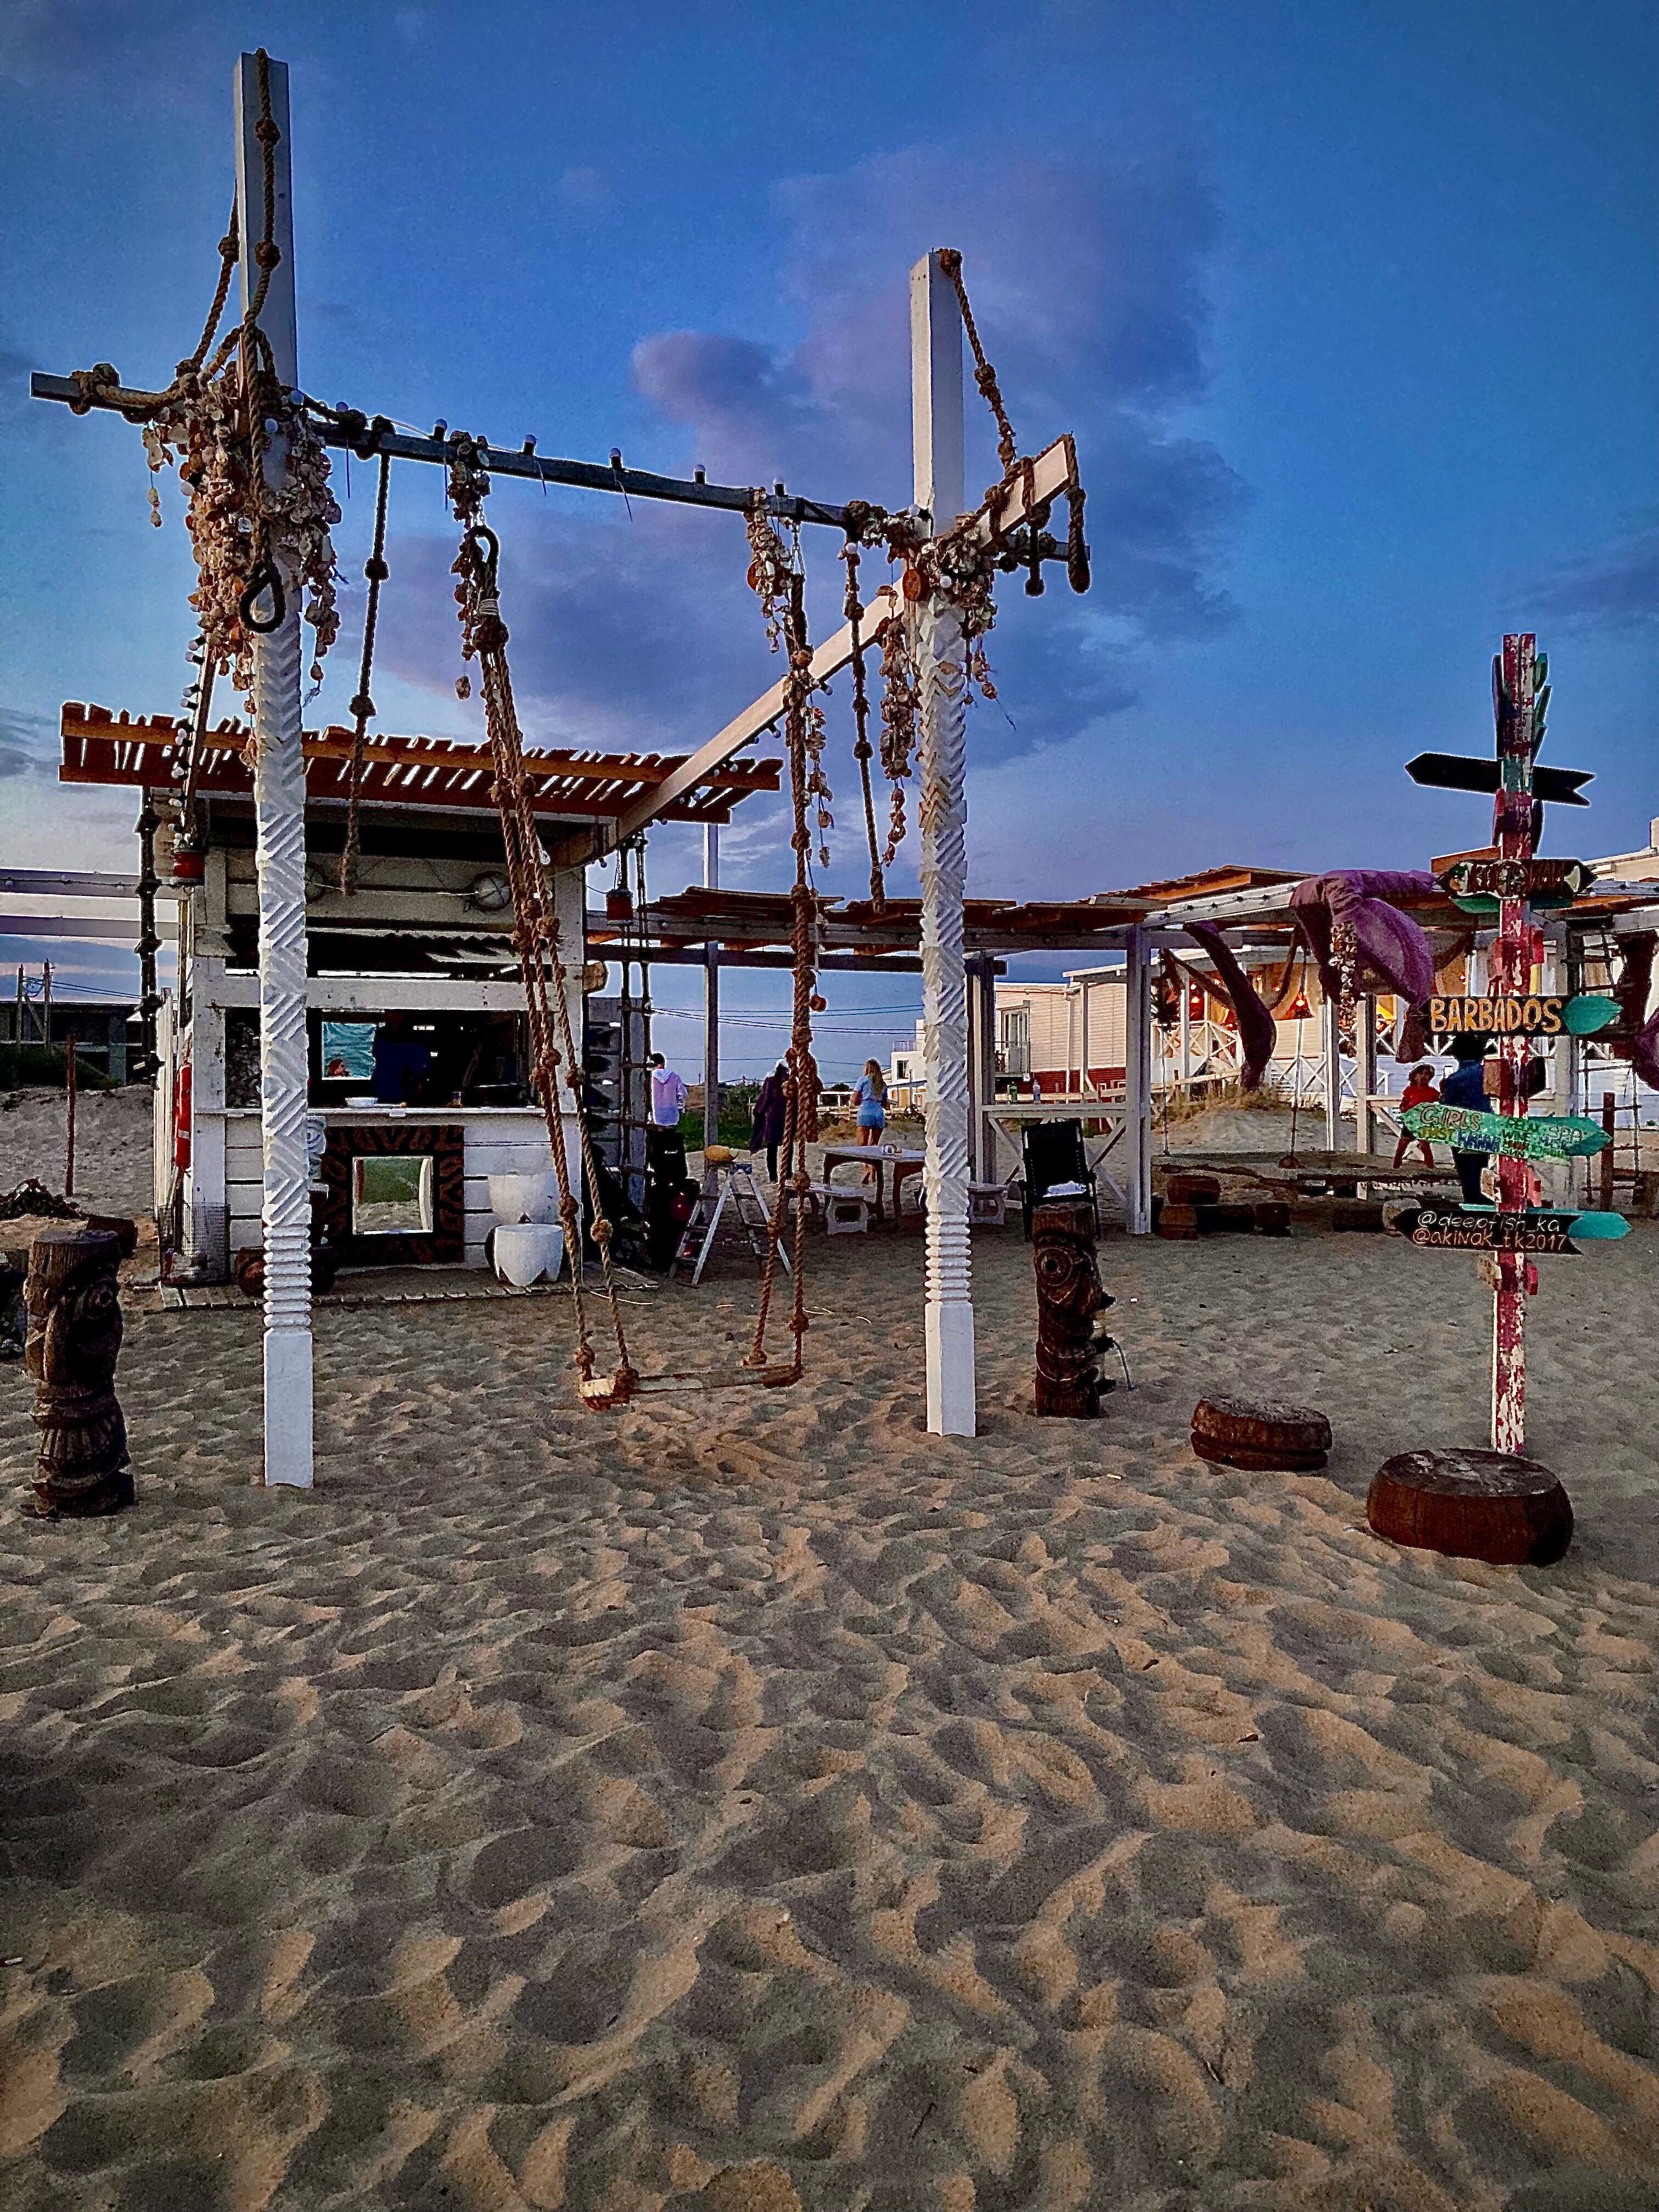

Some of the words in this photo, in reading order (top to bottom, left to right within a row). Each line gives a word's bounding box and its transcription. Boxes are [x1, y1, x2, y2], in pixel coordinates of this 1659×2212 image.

[1431, 998, 1562, 1032] BARBADOS
[1420, 1105, 1481, 1132] GIRLS
[1505, 1118, 1540, 1132] RELAX
[1502, 1129, 1532, 1143] WINE
[1547, 1125, 1583, 1142] SPA
[1418, 1211, 1560, 1232] @deepfish_ka
